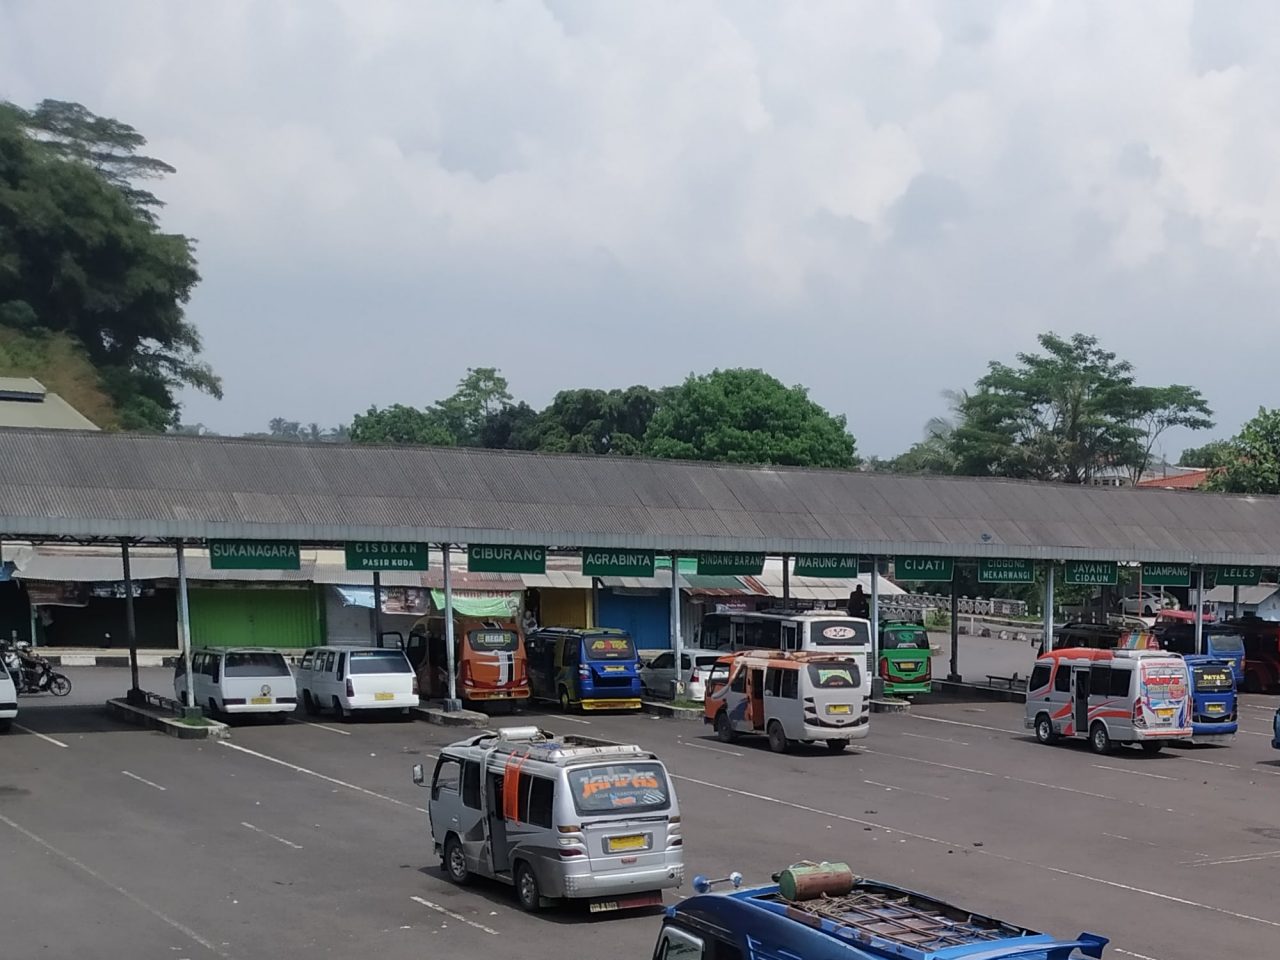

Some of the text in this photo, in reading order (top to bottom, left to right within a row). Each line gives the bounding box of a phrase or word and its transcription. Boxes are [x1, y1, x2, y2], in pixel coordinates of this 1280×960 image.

[213, 543, 296, 557] SUKANAGARA
[355, 543, 417, 553] CISOKAN
[472, 547, 542, 561] CIBURANG
[362, 558, 414, 567] PASIR KUDA
[586, 553, 651, 566] AGRABINTA
[700, 553, 763, 566] SINDANG BARANG
[799, 556, 857, 568] WARUNG AWI
[904, 560, 945, 570] CIJATI
[1072, 562, 1111, 574] JAYANTI
[983, 570, 1030, 579] MEKARWANGI
[1143, 566, 1188, 576] CIJAMPANG
[1223, 568, 1255, 578] LELES
[1075, 574, 1109, 582] CIDAUN
